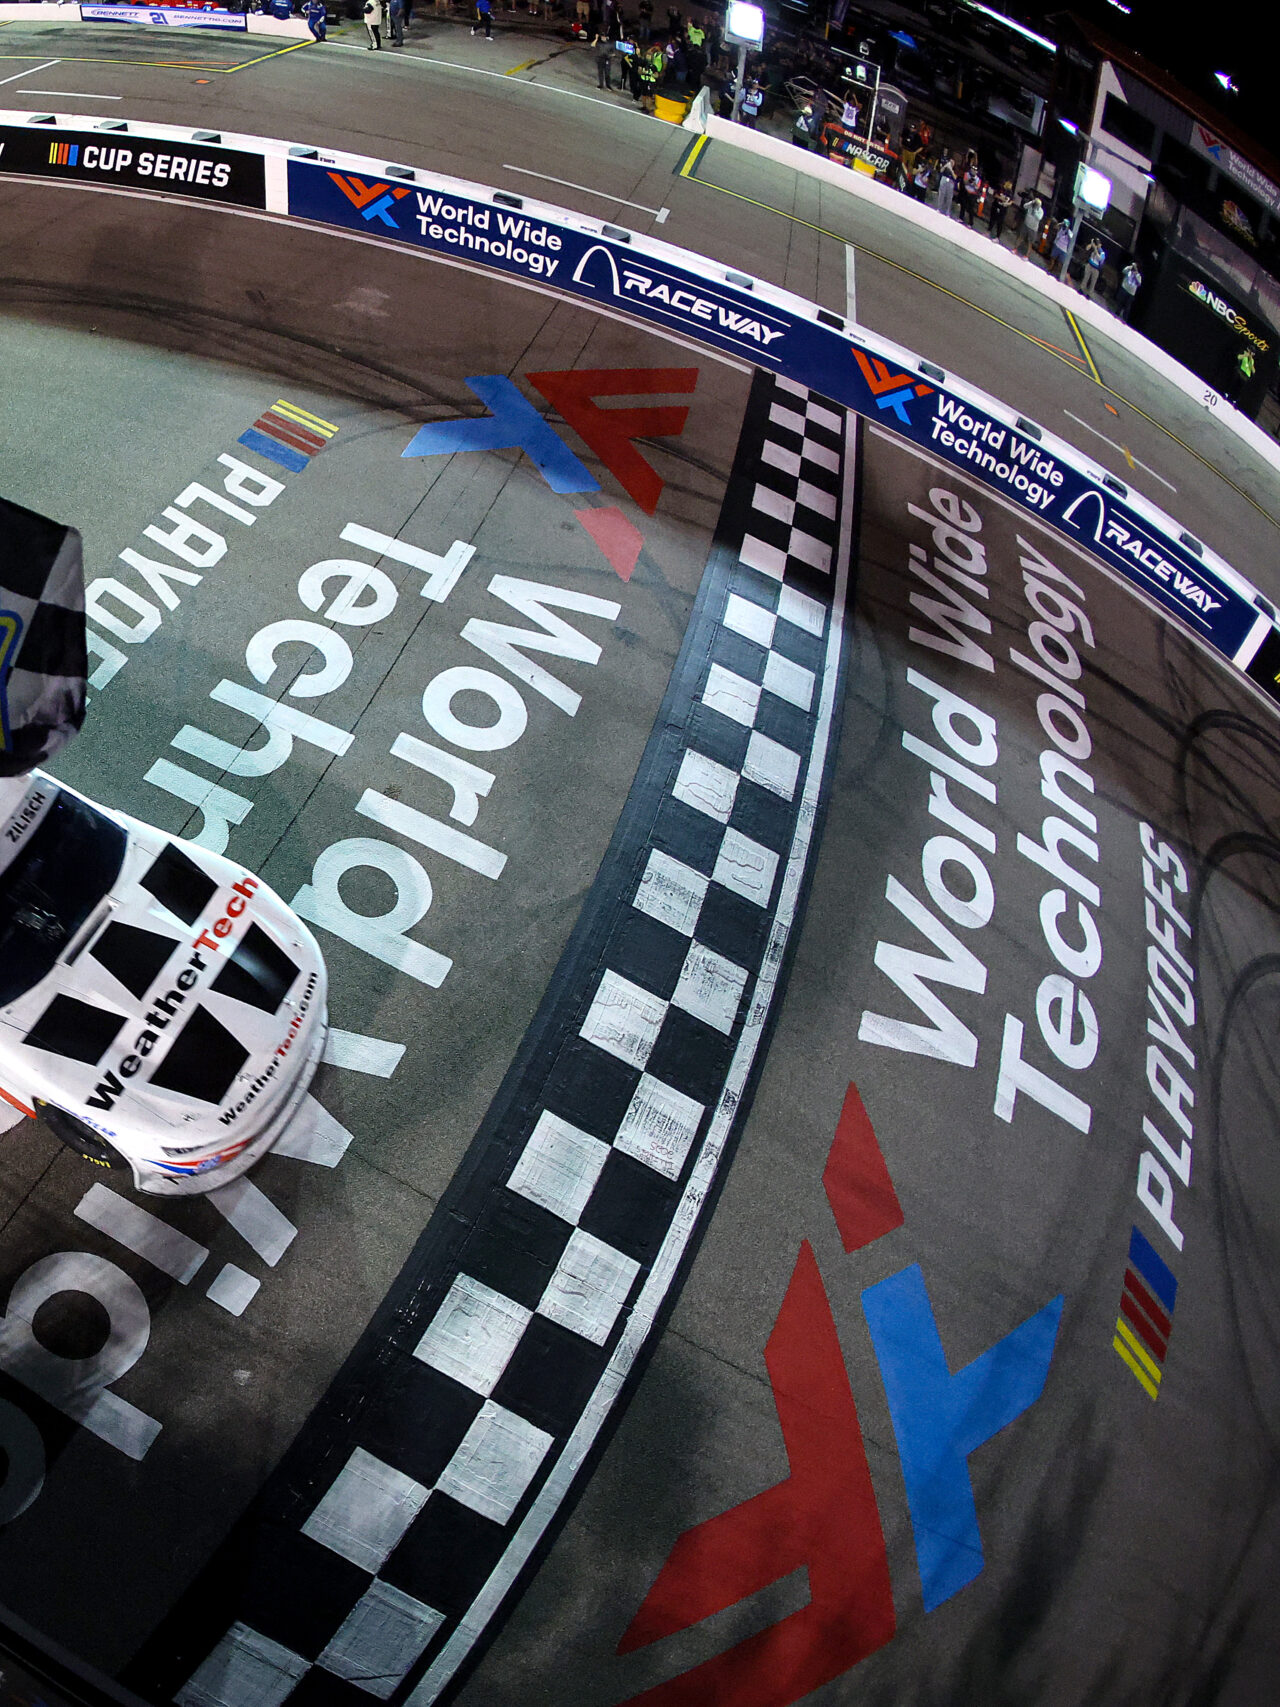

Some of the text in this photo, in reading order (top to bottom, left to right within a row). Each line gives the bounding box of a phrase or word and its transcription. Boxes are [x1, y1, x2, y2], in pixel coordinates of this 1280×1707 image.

[149, 12, 169, 25] 21
[83, 146, 231, 188] CUP SERIES
[1228, 160, 1275, 206] Technology
[1229, 150, 1278, 197] World Wide
[415, 192, 563, 251] World Wide
[416, 215, 559, 277] Technology
[624, 270, 785, 345] RACEWAY
[1205, 291, 1270, 352] NBC Sports
[1202, 390, 1218, 407] 20
[930, 418, 1057, 510] Technology
[937, 394, 1064, 487] World Wide
[1105, 519, 1222, 615] RACEWAY
[293, 574, 622, 989] World
[858, 486, 998, 1068] World Wide
[6, 791, 47, 843] ZILISCH
[993, 534, 1101, 1135] Technology
[85, 877, 259, 1112] WeatherTech
[218, 971, 319, 1126] WeatherTech.com
[1136, 820, 1193, 1253] PLAYOFFS
